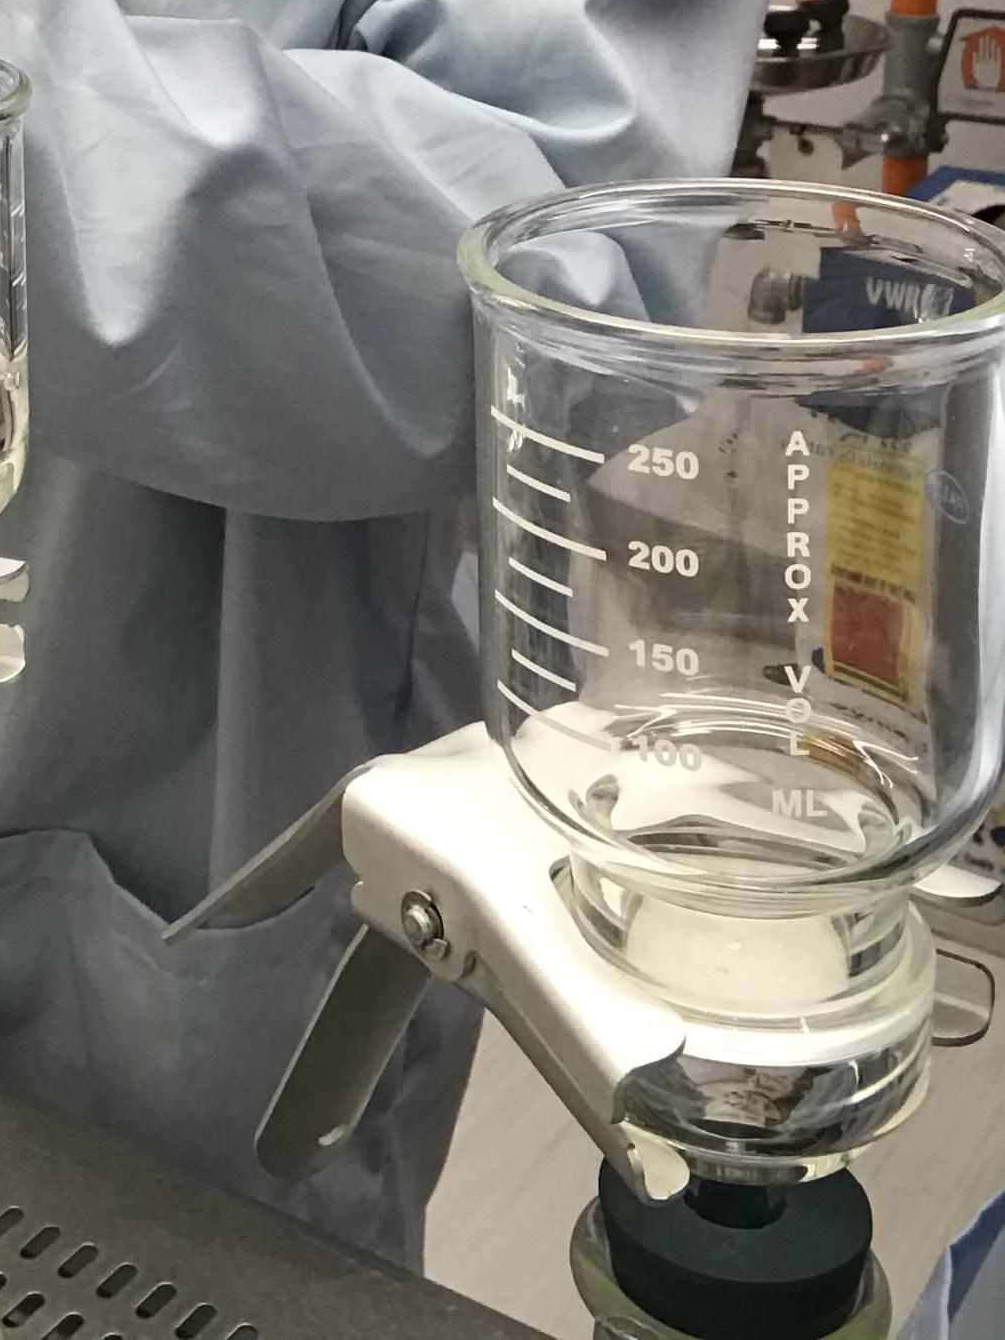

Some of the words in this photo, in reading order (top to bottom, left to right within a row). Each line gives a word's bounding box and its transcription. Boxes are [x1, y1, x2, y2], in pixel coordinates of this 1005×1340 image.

[627, 444, 699, 479] 250
[784, 430, 812, 623] APPROX
[627, 540, 699, 577] 200
[628, 639, 699, 676] 150
[784, 665, 812, 756] VOL
[631, 734, 702, 771] 100
[772, 788, 827, 818] ML
